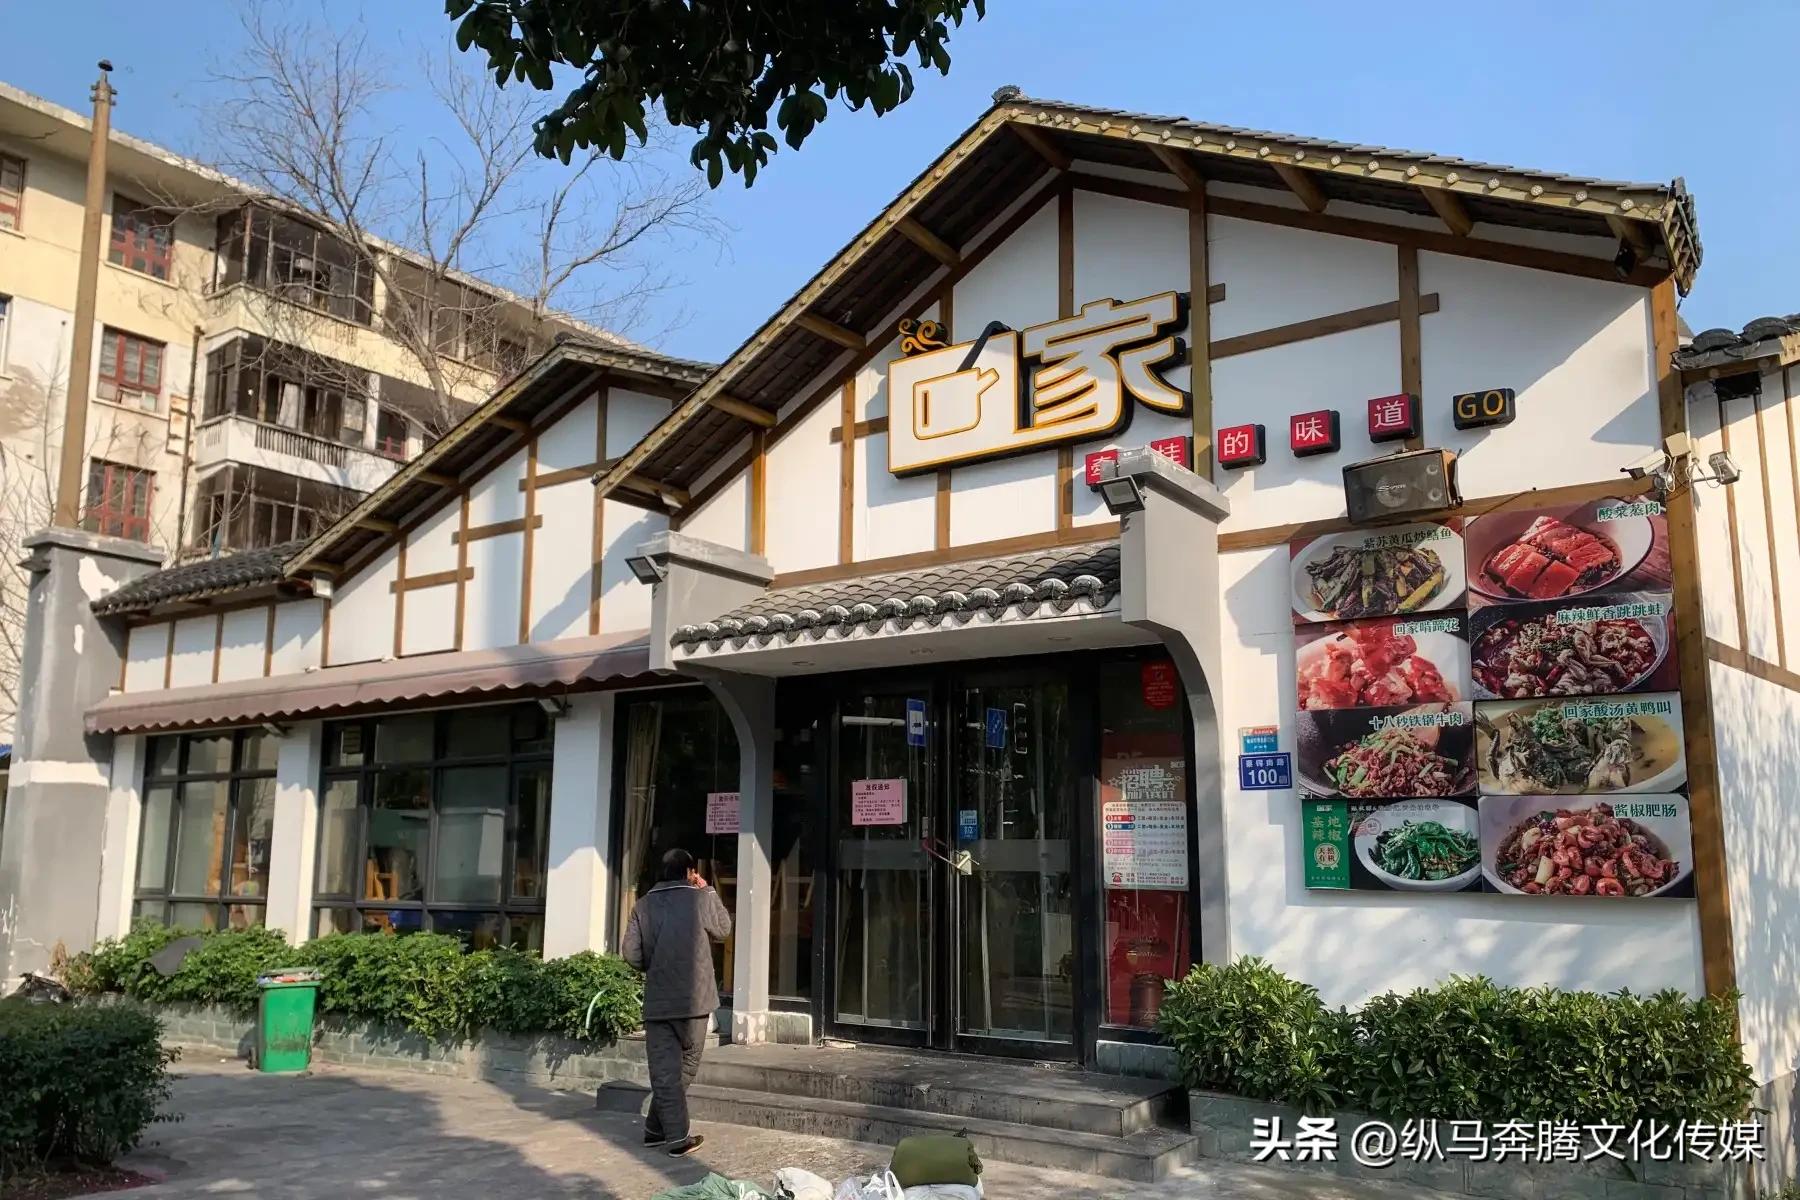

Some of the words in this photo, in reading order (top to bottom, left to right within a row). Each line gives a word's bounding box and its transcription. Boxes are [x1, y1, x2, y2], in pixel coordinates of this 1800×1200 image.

[1457, 390, 1504, 420] GO
[1597, 501, 1660, 522] 酸菜蒸肉
[1557, 602, 1664, 624] 麻辣鲜香跳跳蛙
[1563, 700, 1672, 719] 回家酸汤黄鸭叫
[1368, 711, 1463, 730] 十八秒铁锅牛肉
[1248, 769, 1277, 785] 100
[1614, 803, 1677, 818] 酱椒肥肠
